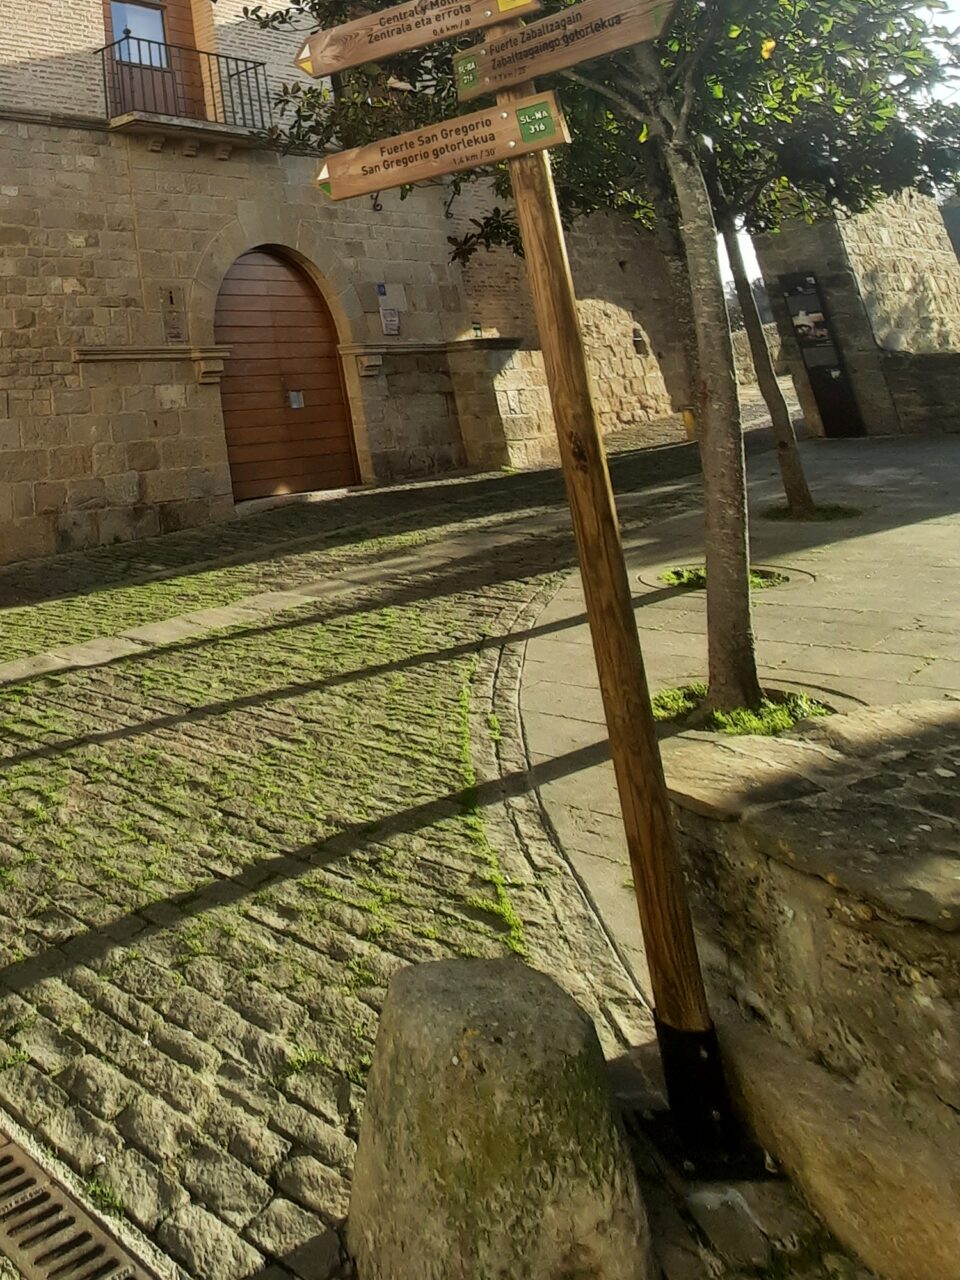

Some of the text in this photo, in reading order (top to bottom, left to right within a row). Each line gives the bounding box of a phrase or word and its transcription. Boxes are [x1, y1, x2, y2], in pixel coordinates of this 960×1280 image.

[367, 3, 472, 44] Zentrala eta errota
[379, 4, 420, 27] Central
[446, 23, 459, 33] km
[489, 11, 583, 56] Fuerte Zabaltzagain
[491, 13, 623, 70] Zabaltzagaingo gotorlekua
[519, 110, 549, 124] SL-NA
[529, 122, 546, 134] 316
[379, 118, 492, 157] Fuerte San Gregorio
[361, 132, 496, 176] San Gregorio gotorlekua
[465, 153, 479, 163] km
